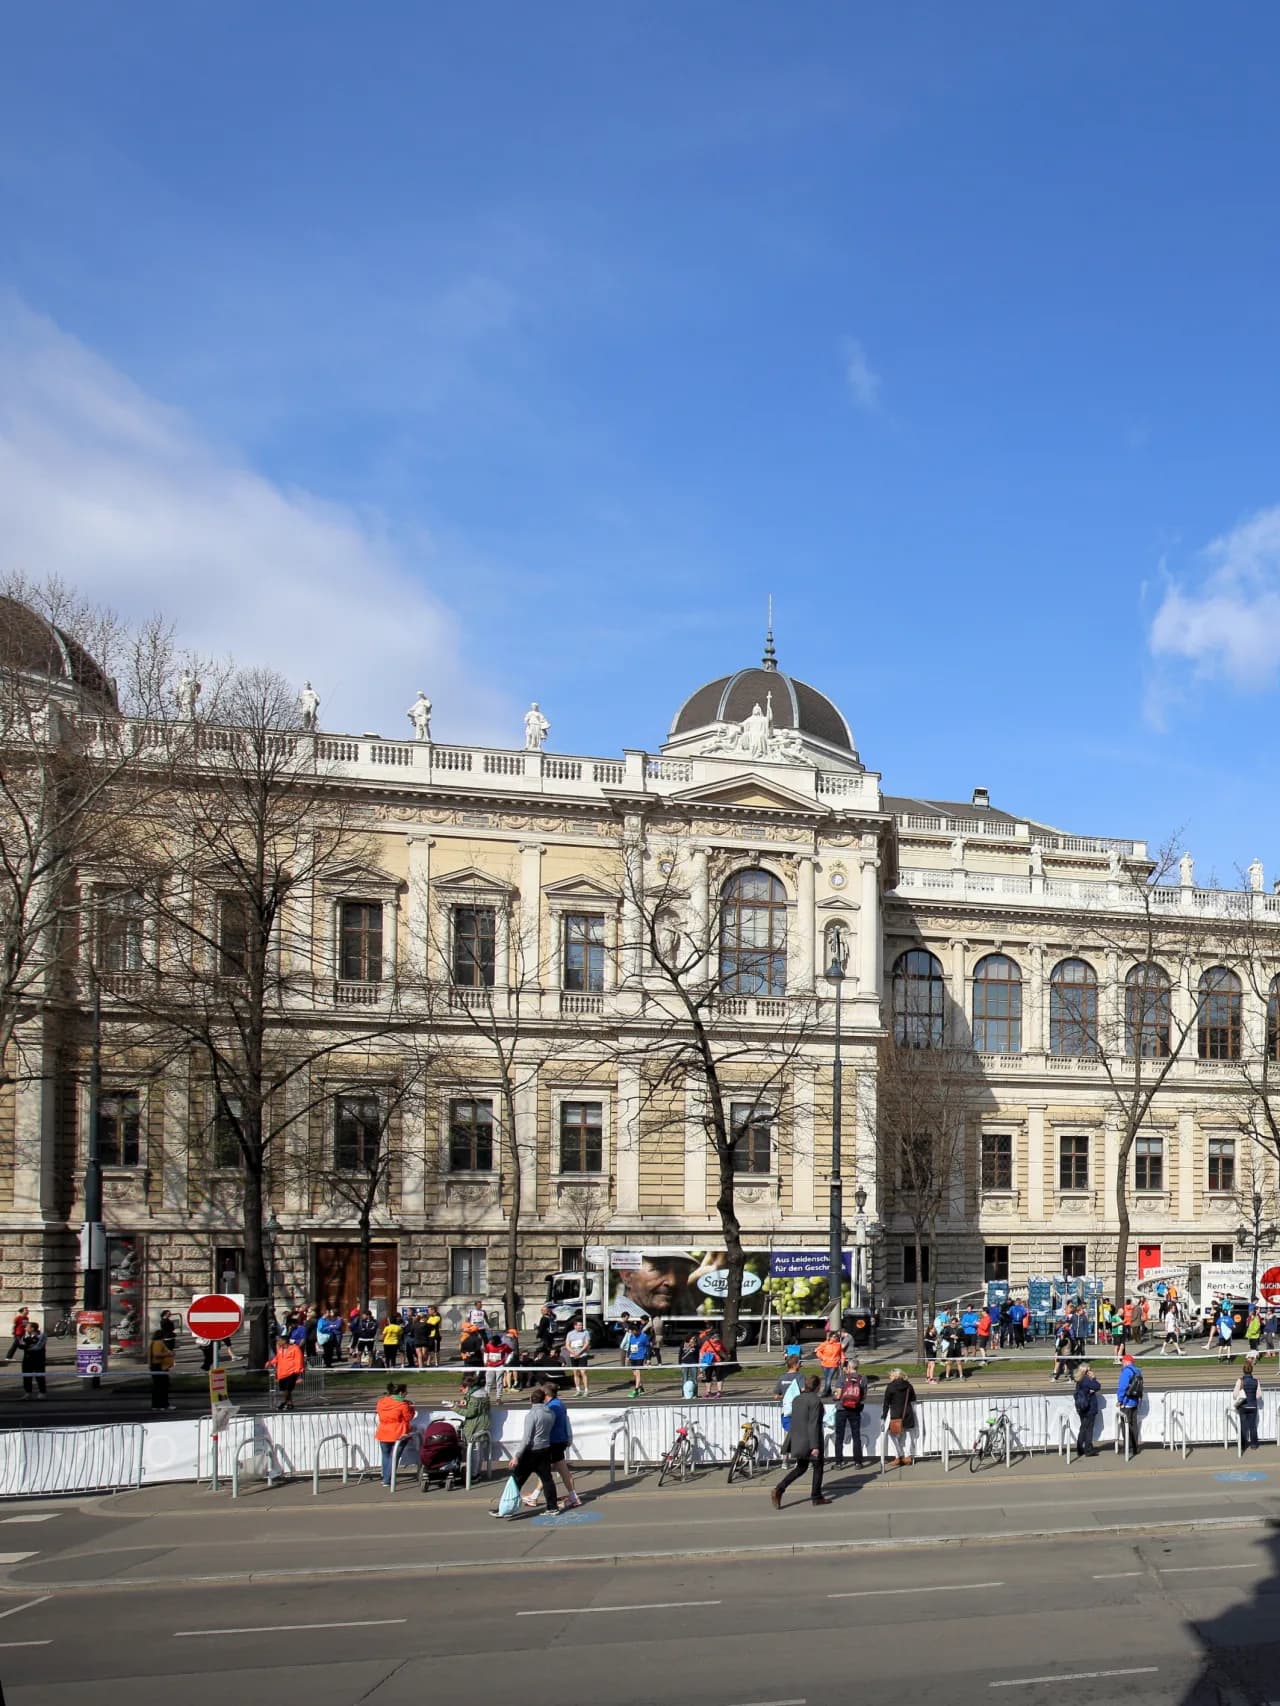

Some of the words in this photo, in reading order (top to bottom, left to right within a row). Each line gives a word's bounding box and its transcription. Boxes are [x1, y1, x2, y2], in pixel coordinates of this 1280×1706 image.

[775, 1264, 788, 1272] für
[791, 1264, 803, 1272] den
[1207, 1282, 1252, 1290] Rent-a-Car
